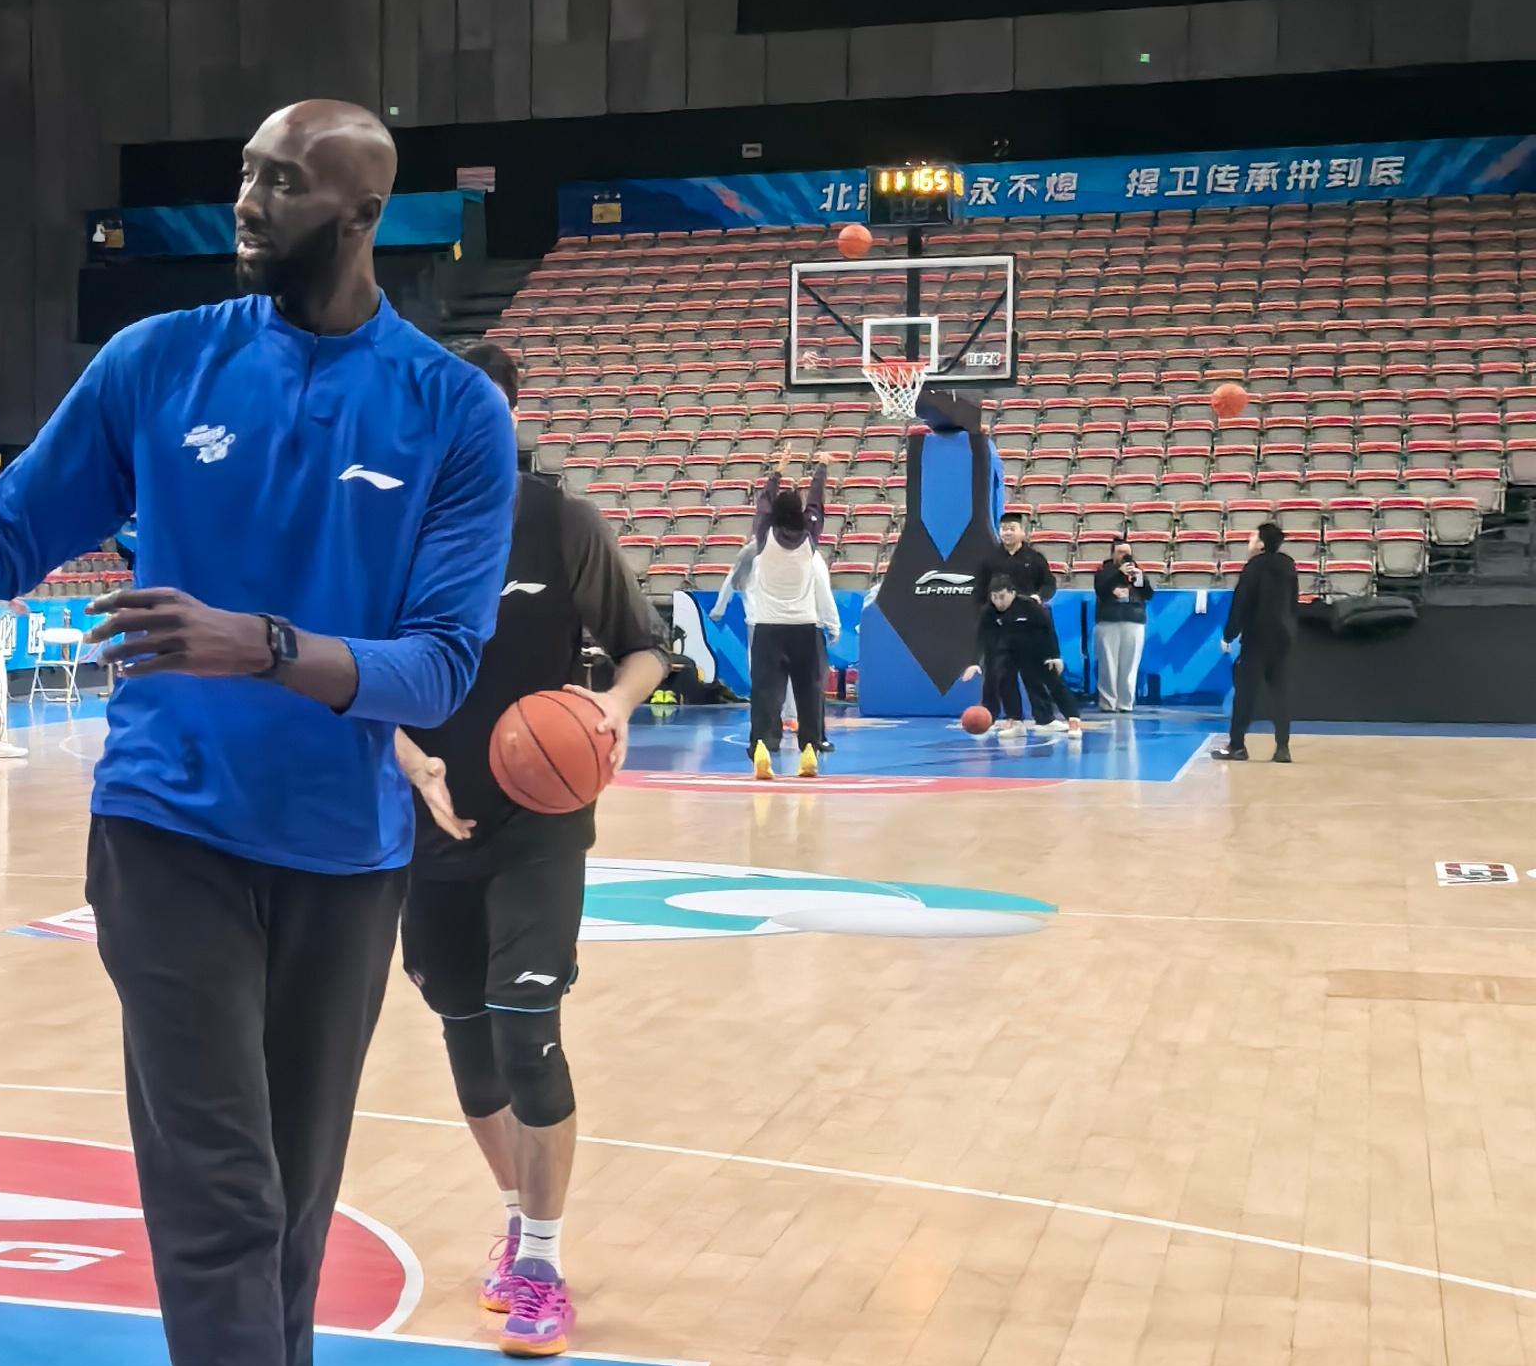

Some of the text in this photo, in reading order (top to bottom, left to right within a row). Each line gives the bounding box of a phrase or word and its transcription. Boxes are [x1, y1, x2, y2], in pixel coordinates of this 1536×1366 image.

[1125, 156, 1405, 198] 捍卫传承拼到底
